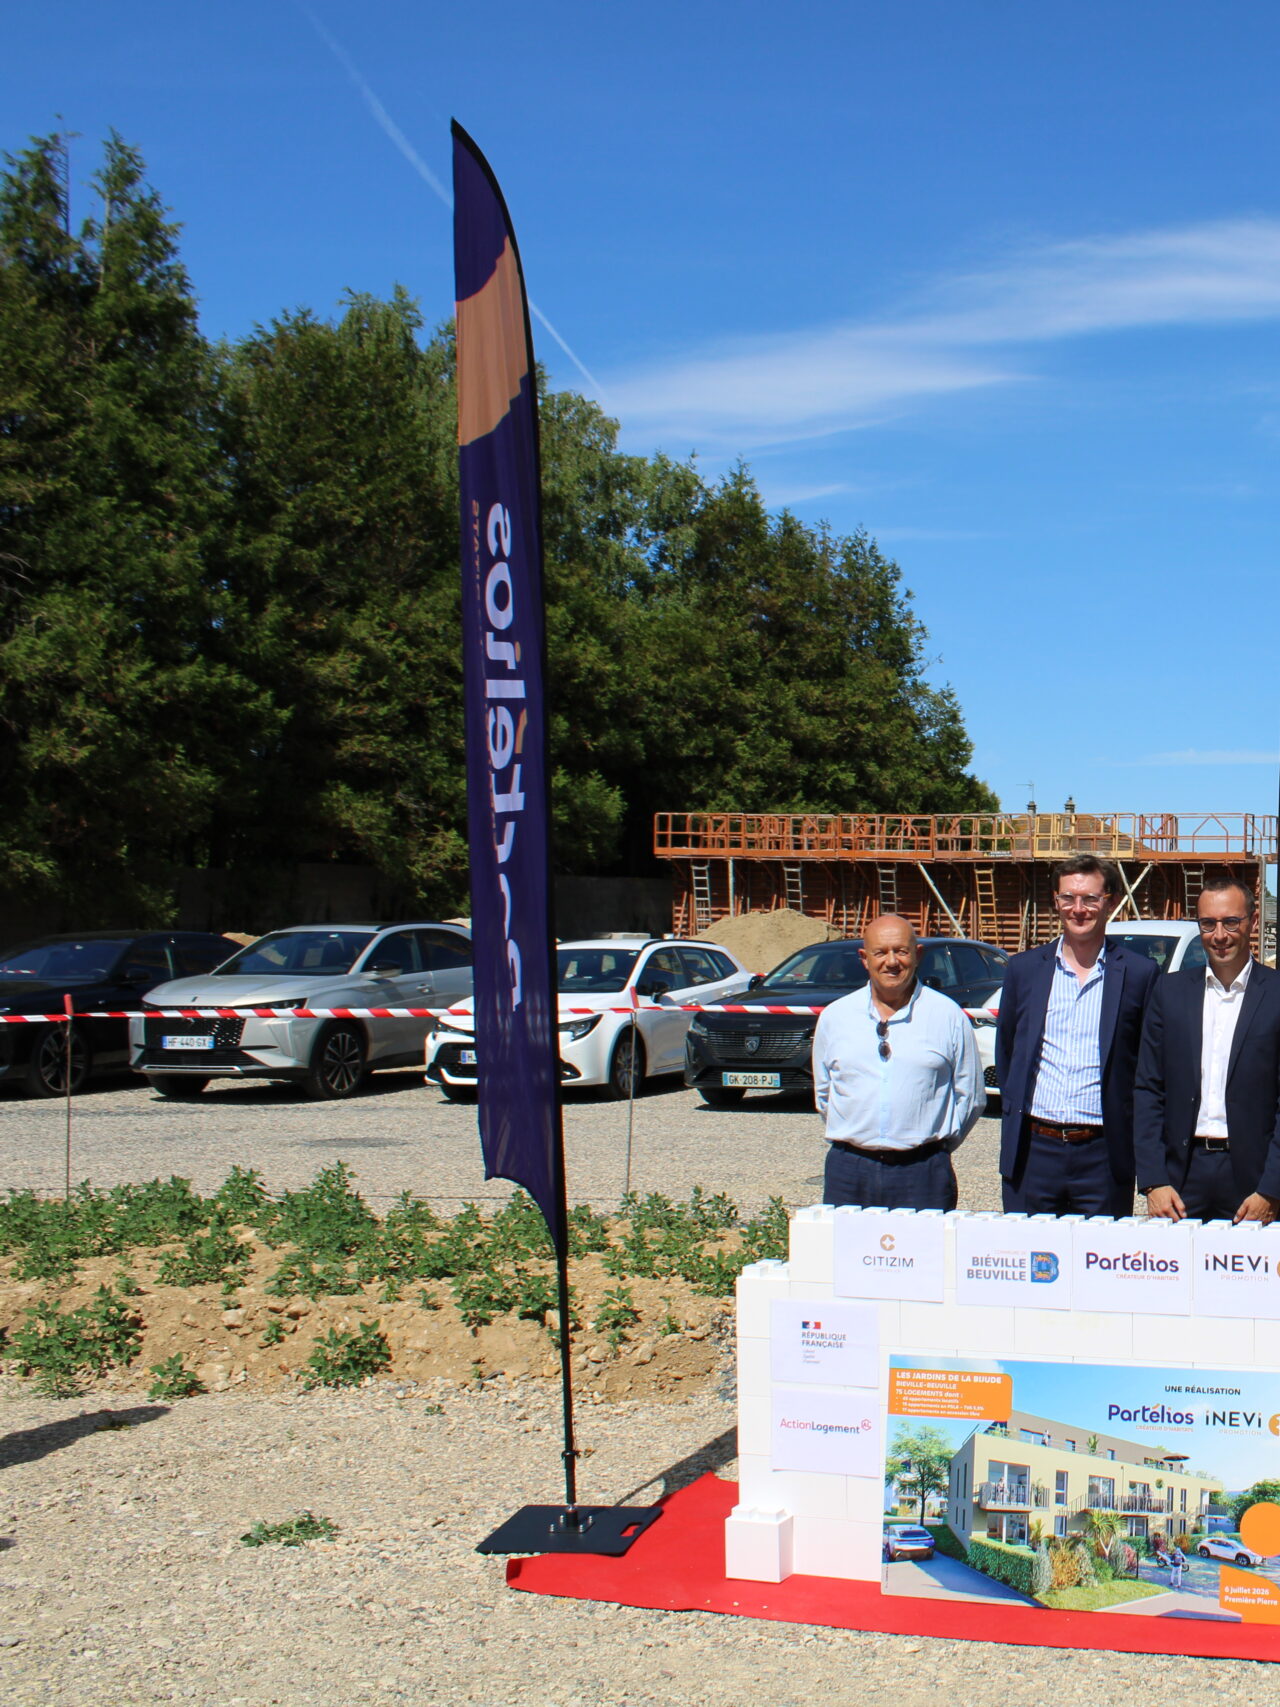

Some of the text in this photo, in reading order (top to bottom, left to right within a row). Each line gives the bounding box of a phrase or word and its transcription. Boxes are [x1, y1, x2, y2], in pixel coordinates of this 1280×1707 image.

[862, 1255, 914, 1268] CITIZIM
[971, 1254, 1027, 1268] BIÉVILLE
[1086, 1250, 1180, 1273] Partélios
[967, 1269, 1027, 1281] BEUVILLE
[1220, 1274, 1269, 1282] PROMOTION
[801, 1331, 847, 1341] RÉPUBLIQUE
[801, 1340, 844, 1349] FRANÇAISE
[896, 1371, 910, 1379] LES
[912, 1372, 947, 1381] JARDINS
[904, 1389, 943, 1397] LOGEMENTS
[1164, 1384, 1241, 1395] UNE RÉALISATION
[1108, 1403, 1194, 1425] Partélios
[780, 1418, 860, 1434] ActionLogement
[1219, 1428, 1262, 1436] PROMOTION
[1230, 1586, 1251, 1594] juillet
[1224, 1595, 1278, 1606] Première Pierre
